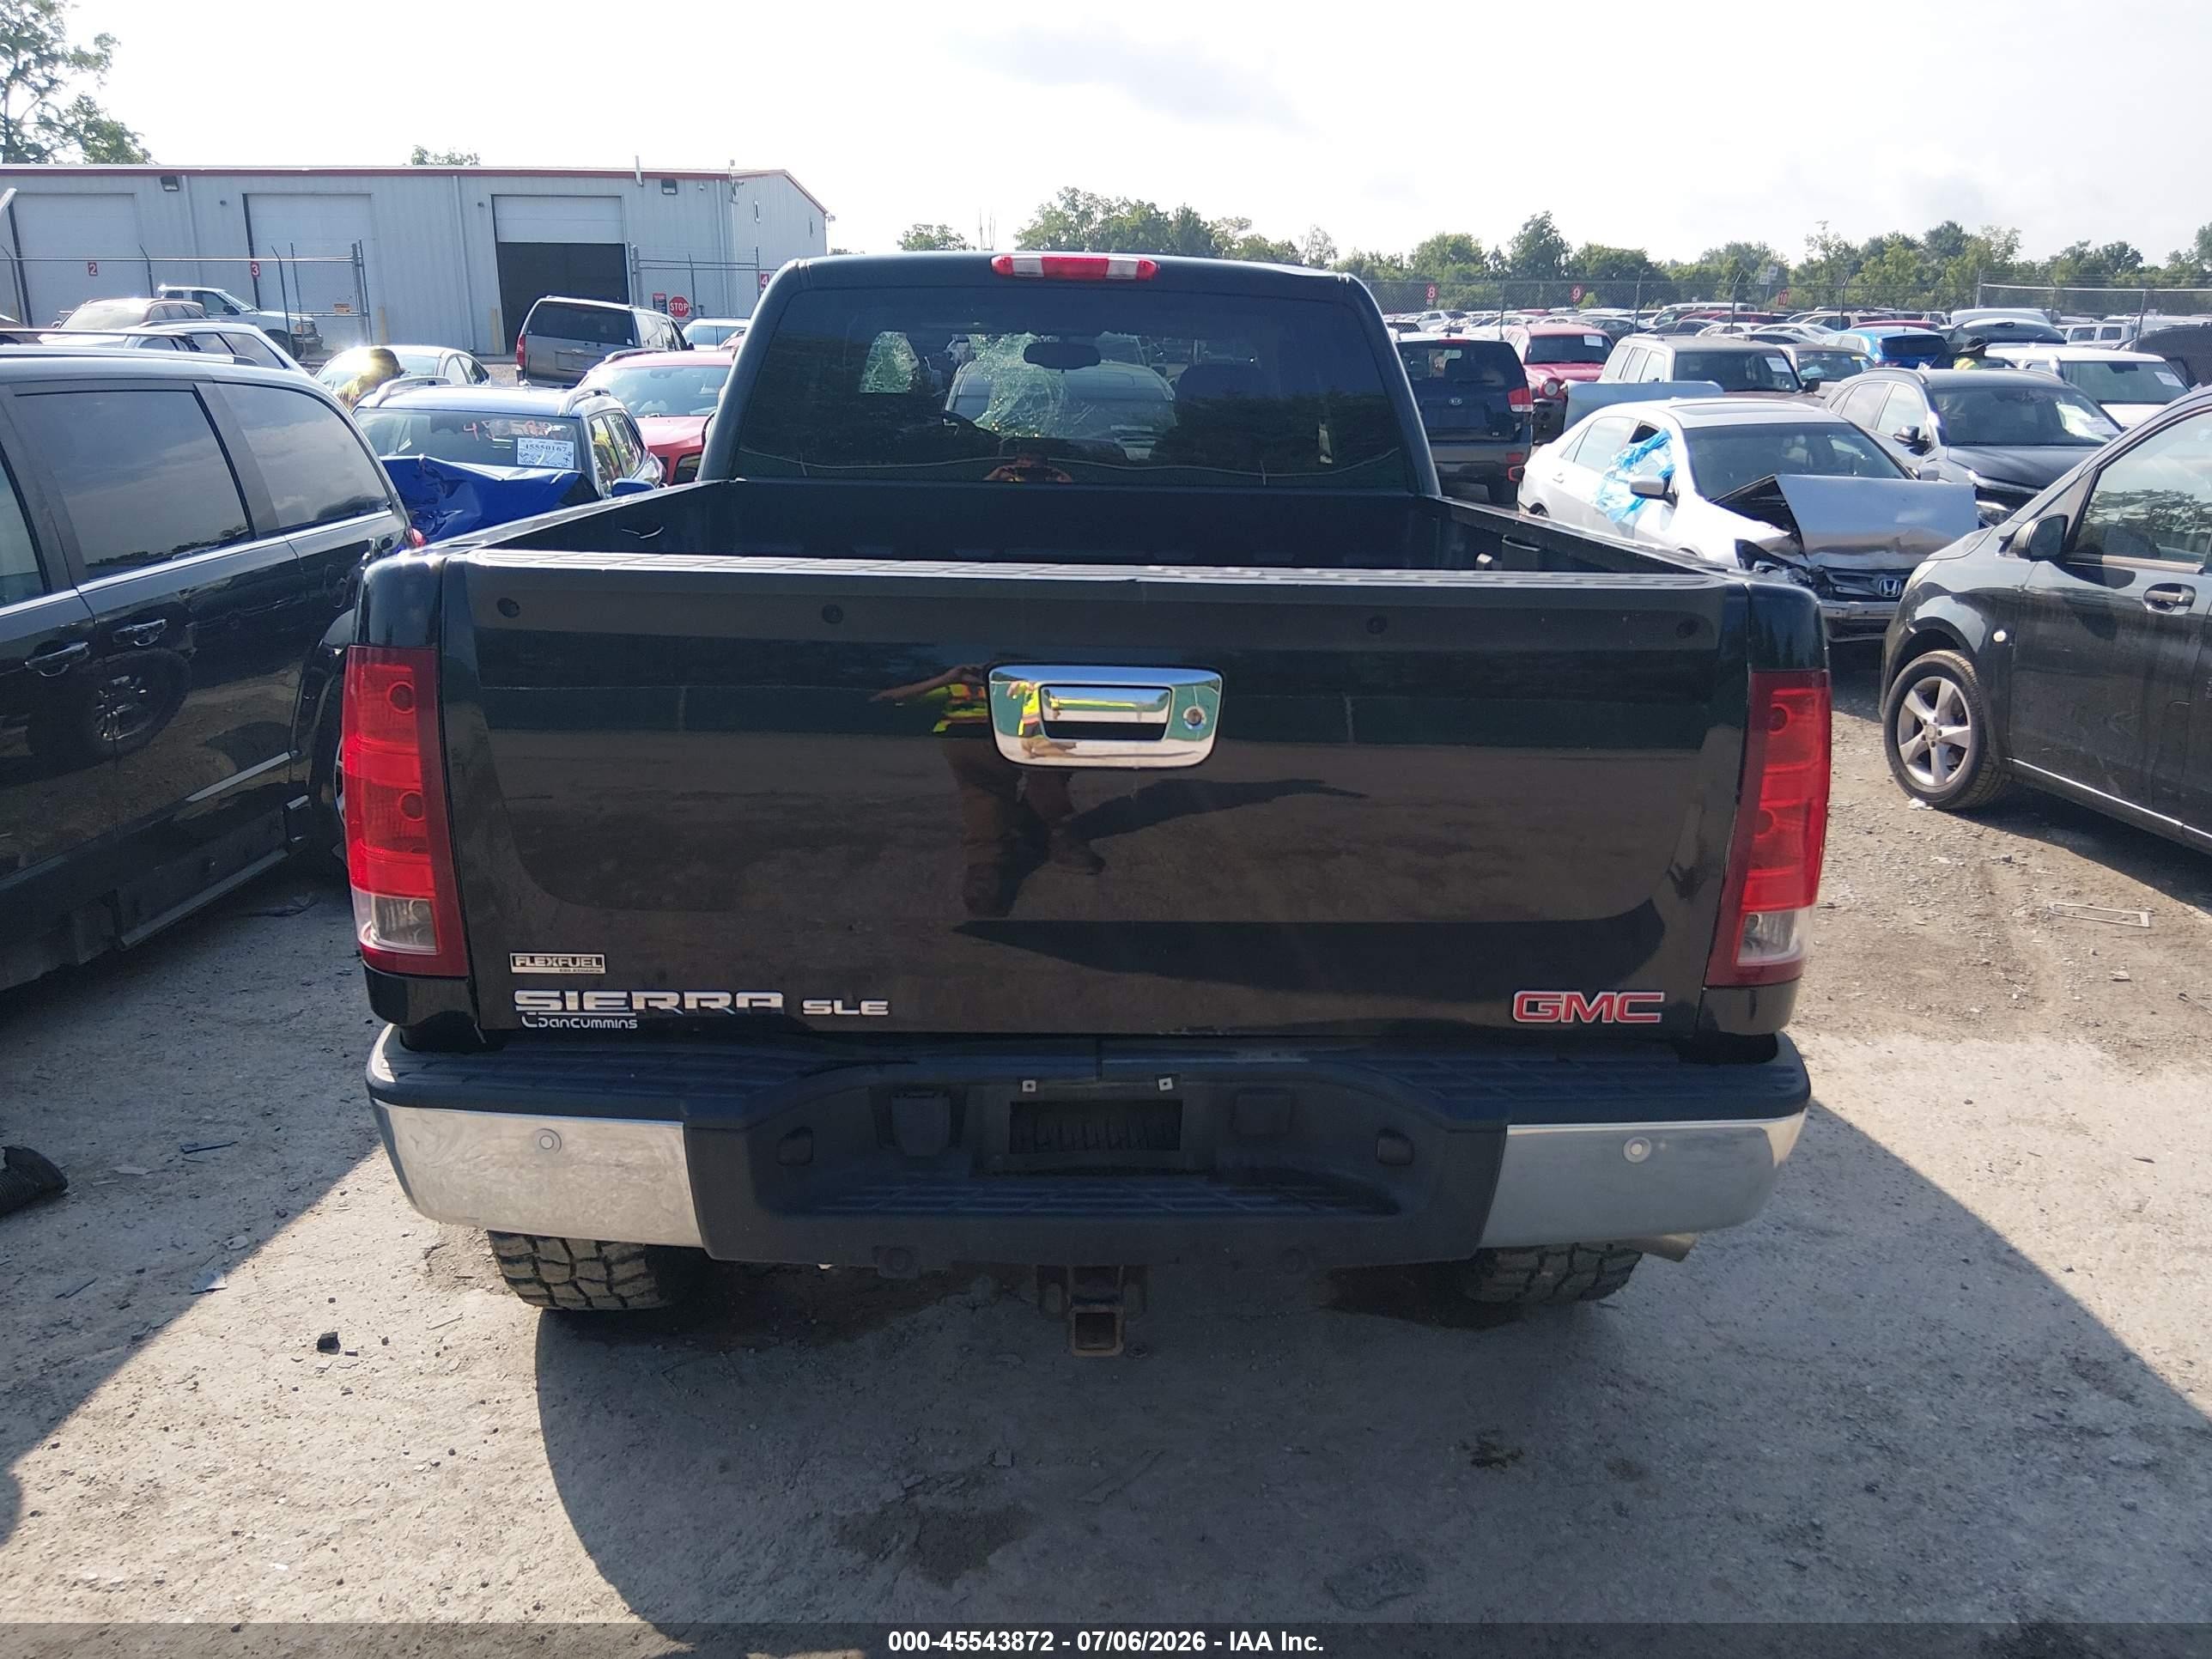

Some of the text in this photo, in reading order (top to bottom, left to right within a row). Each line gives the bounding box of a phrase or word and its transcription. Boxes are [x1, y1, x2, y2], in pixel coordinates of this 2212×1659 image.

[89, 264, 97, 276] 2
[252, 264, 259, 276] 3
[761, 276, 769, 285] 4
[1428, 287, 1436, 298] 8
[1572, 288, 1581, 300] 9
[670, 302, 689, 312] STOP
[515, 956, 602, 968] FLEXFUEL
[514, 990, 889, 1016] SIERRA SLE
[1513, 990, 1665, 1024] GMC
